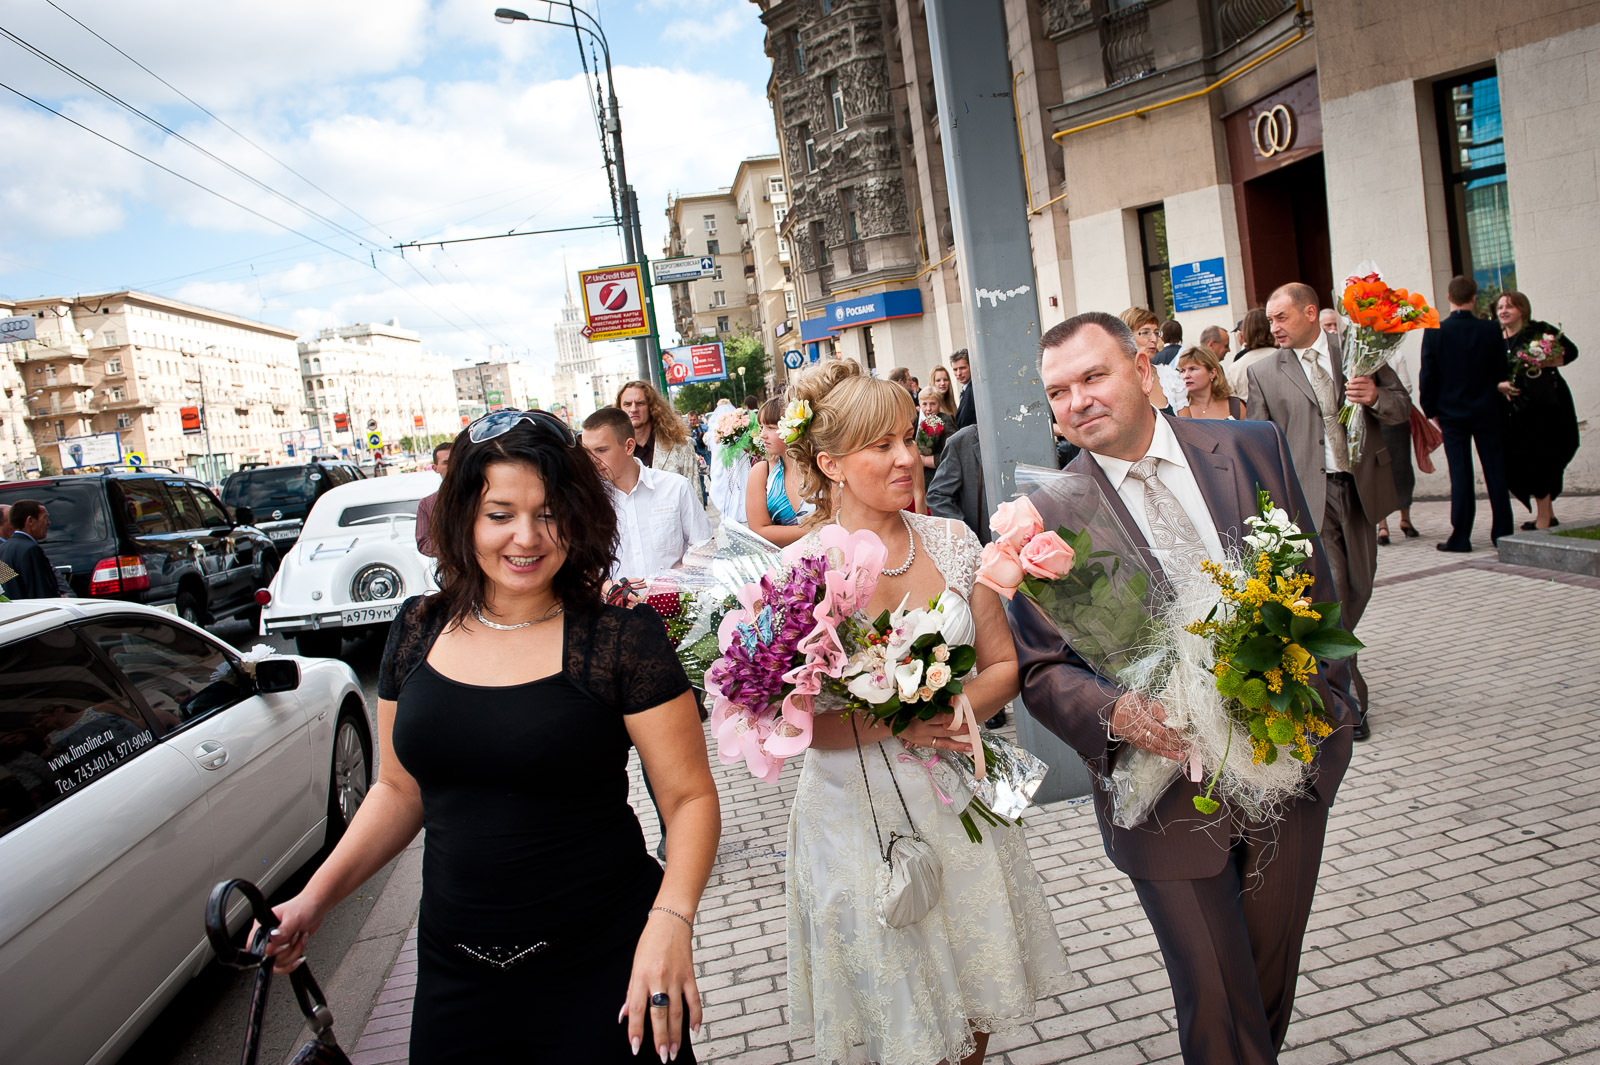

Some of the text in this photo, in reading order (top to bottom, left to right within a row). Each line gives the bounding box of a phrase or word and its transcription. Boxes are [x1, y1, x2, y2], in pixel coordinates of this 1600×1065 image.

[593, 272, 620, 282] UniCredit
[846, 304, 876, 317] РОСБАНК
[674, 364, 687, 378] 0!
[346, 610, 392, 623] А979УМ
[48, 730, 114, 772] www.limoline.ru
[55, 730, 153, 794] Тел. 743-4014, 971-9040
